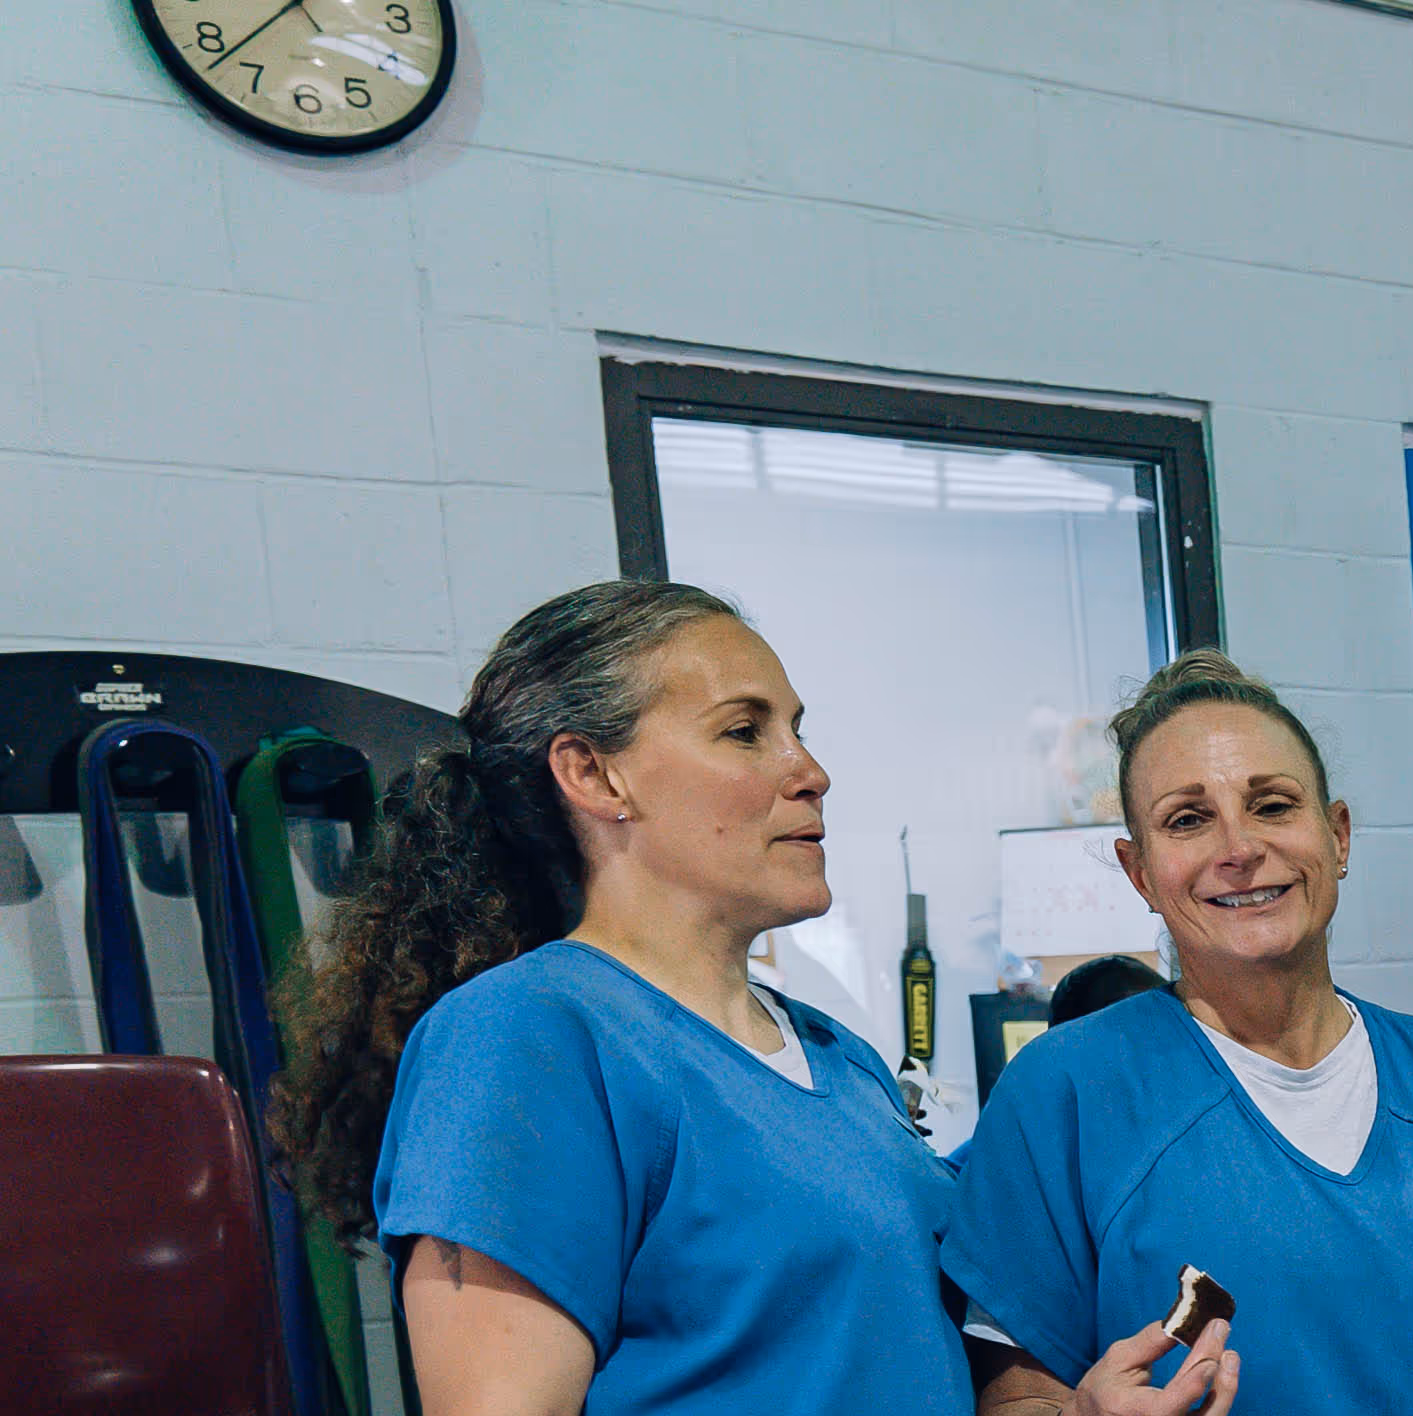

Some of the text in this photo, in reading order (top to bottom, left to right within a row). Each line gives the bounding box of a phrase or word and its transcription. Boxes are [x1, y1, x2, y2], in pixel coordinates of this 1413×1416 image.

[384, 3, 412, 34] 3
[196, 21, 225, 53] 8
[239, 61, 265, 94] 7
[344, 76, 373, 109] 5
[293, 83, 323, 114] 6
